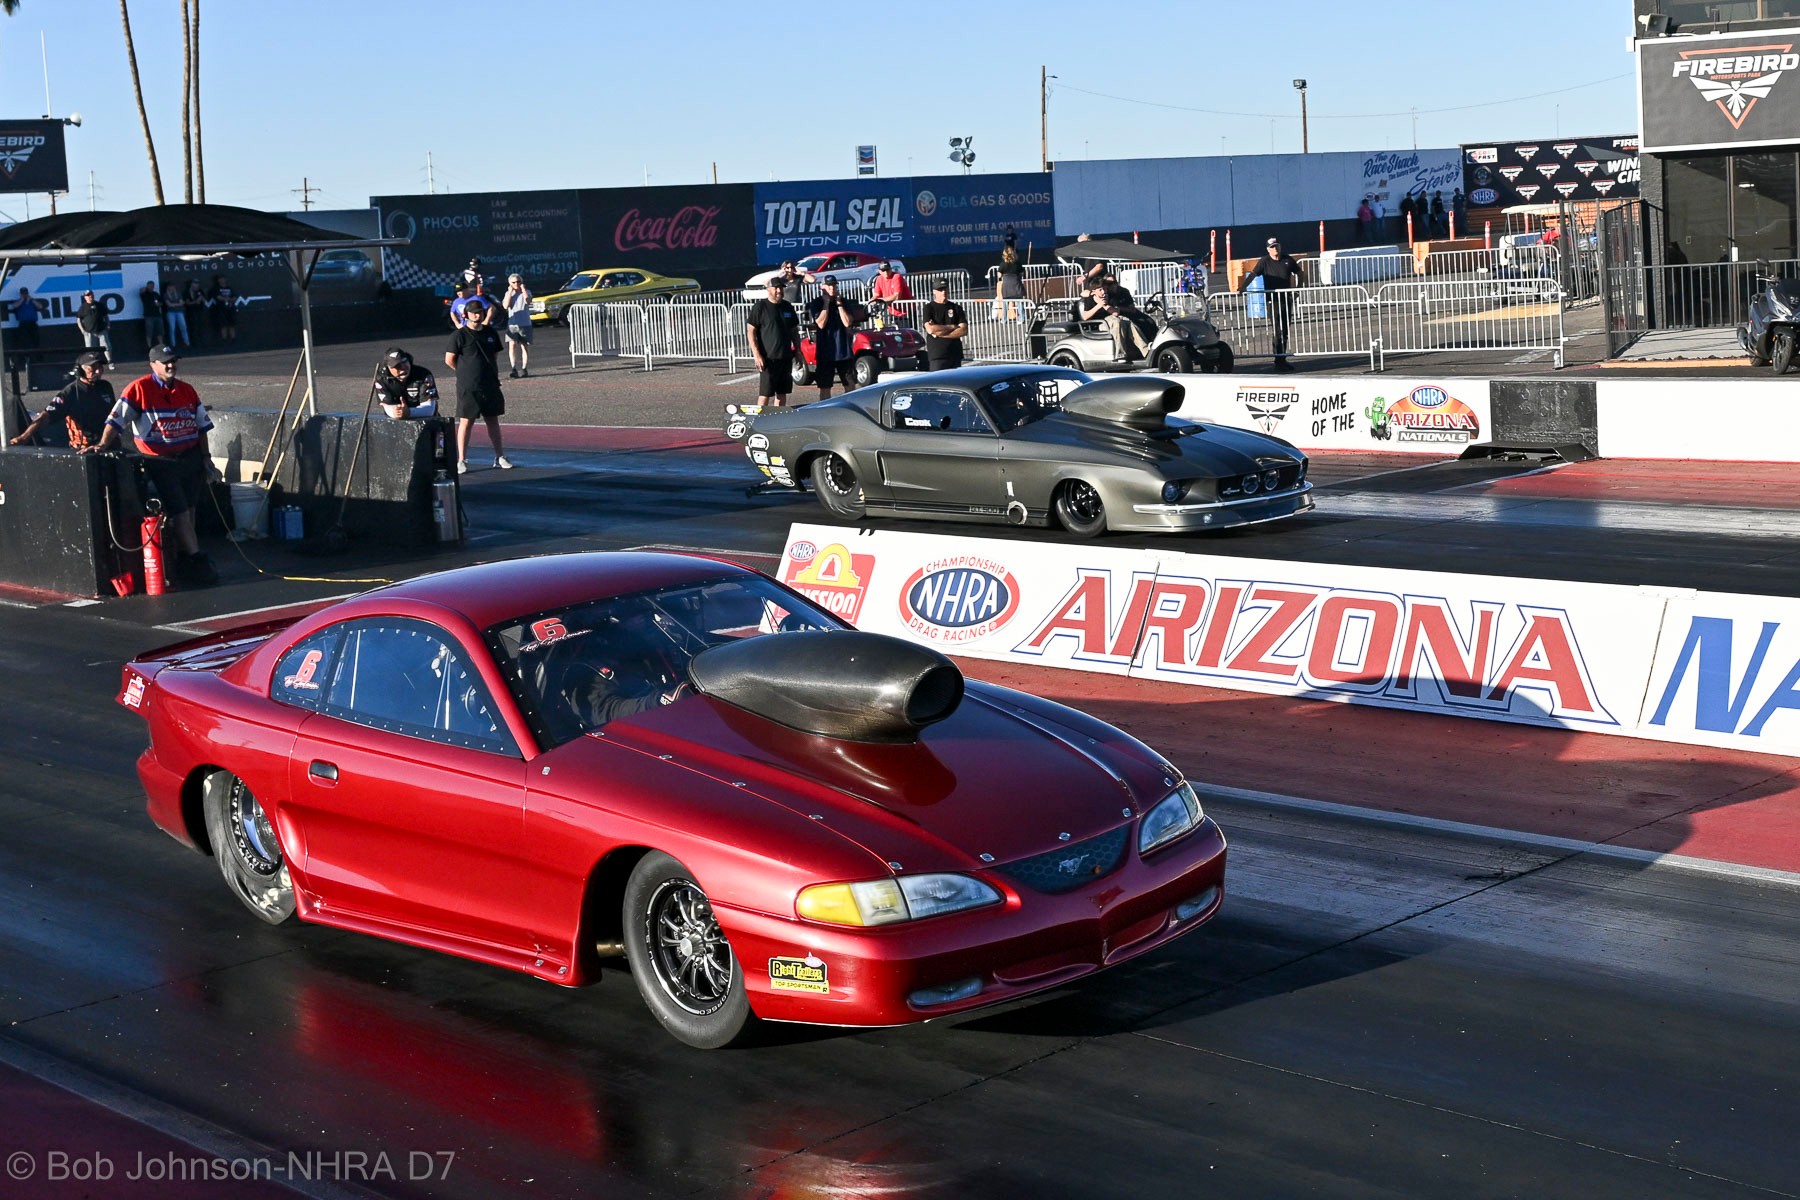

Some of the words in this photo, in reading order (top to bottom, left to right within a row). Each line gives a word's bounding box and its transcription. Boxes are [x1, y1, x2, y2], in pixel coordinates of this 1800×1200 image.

[1672, 54, 1799, 77] FIREBIRD
[1364, 158, 1388, 178] Race
[1387, 153, 1418, 173] Shack
[1374, 152, 1388, 163] The
[940, 196, 968, 208] GILA
[970, 194, 996, 206] GAS
[998, 194, 1006, 205] &
[1009, 192, 1051, 205] GOODS
[1473, 191, 1496, 201] NHRA
[491, 211, 507, 219] TAX
[517, 209, 569, 218] ACCOUNTING
[764, 200, 839, 234] TOTAL
[846, 198, 904, 231] SEAL
[423, 216, 480, 229] PHOCUS
[493, 221, 543, 231] INVESTMENTS
[614, 205, 721, 252] Coca-Cola
[938, 224, 955, 232] LIVE
[956, 223, 973, 232] OUR
[975, 223, 989, 231] LIFE
[991, 222, 998, 230] A
[494, 234, 537, 242] INSURANCE
[767, 236, 839, 248] PISTON
[846, 233, 902, 244] RINGS
[951, 236, 972, 245] FROM
[973, 236, 988, 244] THE
[164, 262, 218, 272] RACING
[228, 260, 283, 269] SCHOOL
[505, 261, 579, 277] 602-457-2191
[1236, 392, 1299, 403] FIREBIRD
[1415, 388, 1446, 403] NHRA
[1312, 392, 1347, 416] HOME
[1312, 420, 1328, 437] OF
[1332, 412, 1355, 432] THE
[1389, 412, 1477, 429] ARIZONA
[1401, 431, 1468, 443] NATIONALS
[791, 543, 815, 559] NHRA
[926, 556, 1005, 575] CHAMPIONSHIP
[916, 571, 998, 624] NHRA
[530, 617, 567, 642] 6
[910, 617, 938, 639] DRAG
[943, 628, 987, 641] RACING
[1012, 568, 1618, 725] ARIZONA
[296, 649, 323, 683] 6
